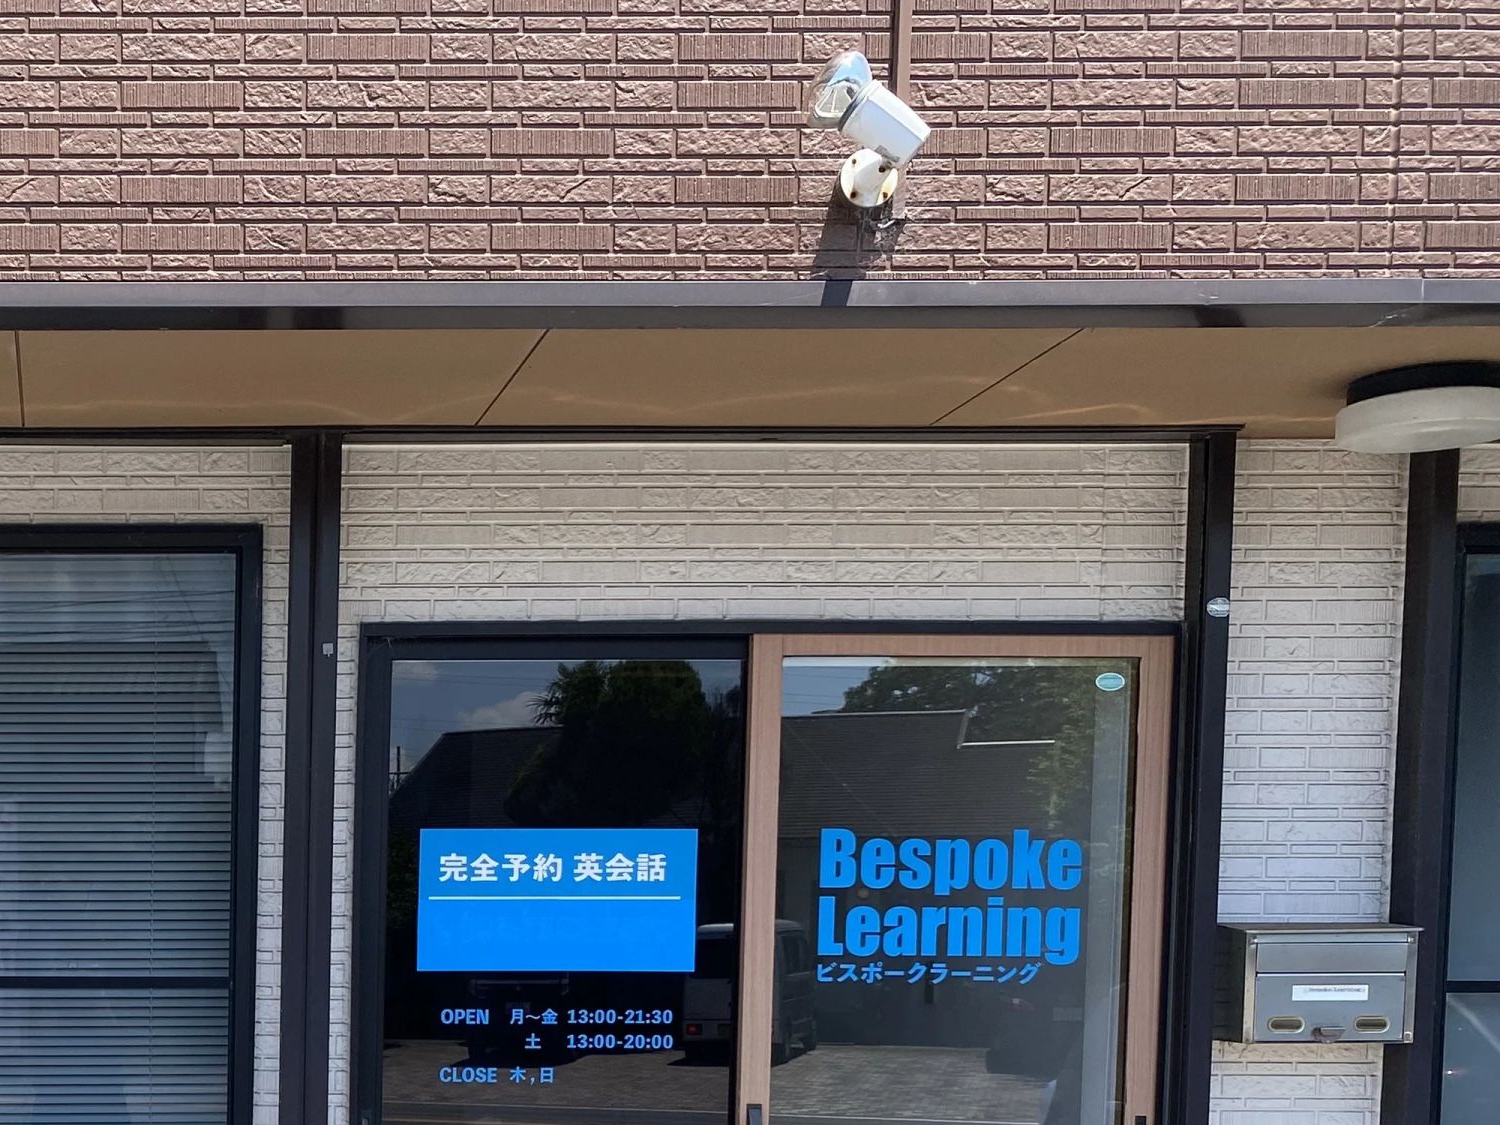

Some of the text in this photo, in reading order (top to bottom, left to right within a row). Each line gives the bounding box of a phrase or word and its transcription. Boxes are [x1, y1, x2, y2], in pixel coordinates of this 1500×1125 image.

[438, 853, 666, 882] 完全予約 英会話
[819, 828, 1082, 896] Bespoke
[817, 896, 1081, 965] Learning
[817, 961, 1042, 984] ビスポークラーニング
[440, 1009, 489, 1025] OPEN
[567, 1009, 673, 1024] 13:00-21:30
[524, 1033, 673, 1049] 土 13:00-20:00
[439, 1067, 498, 1083] CLOSE
